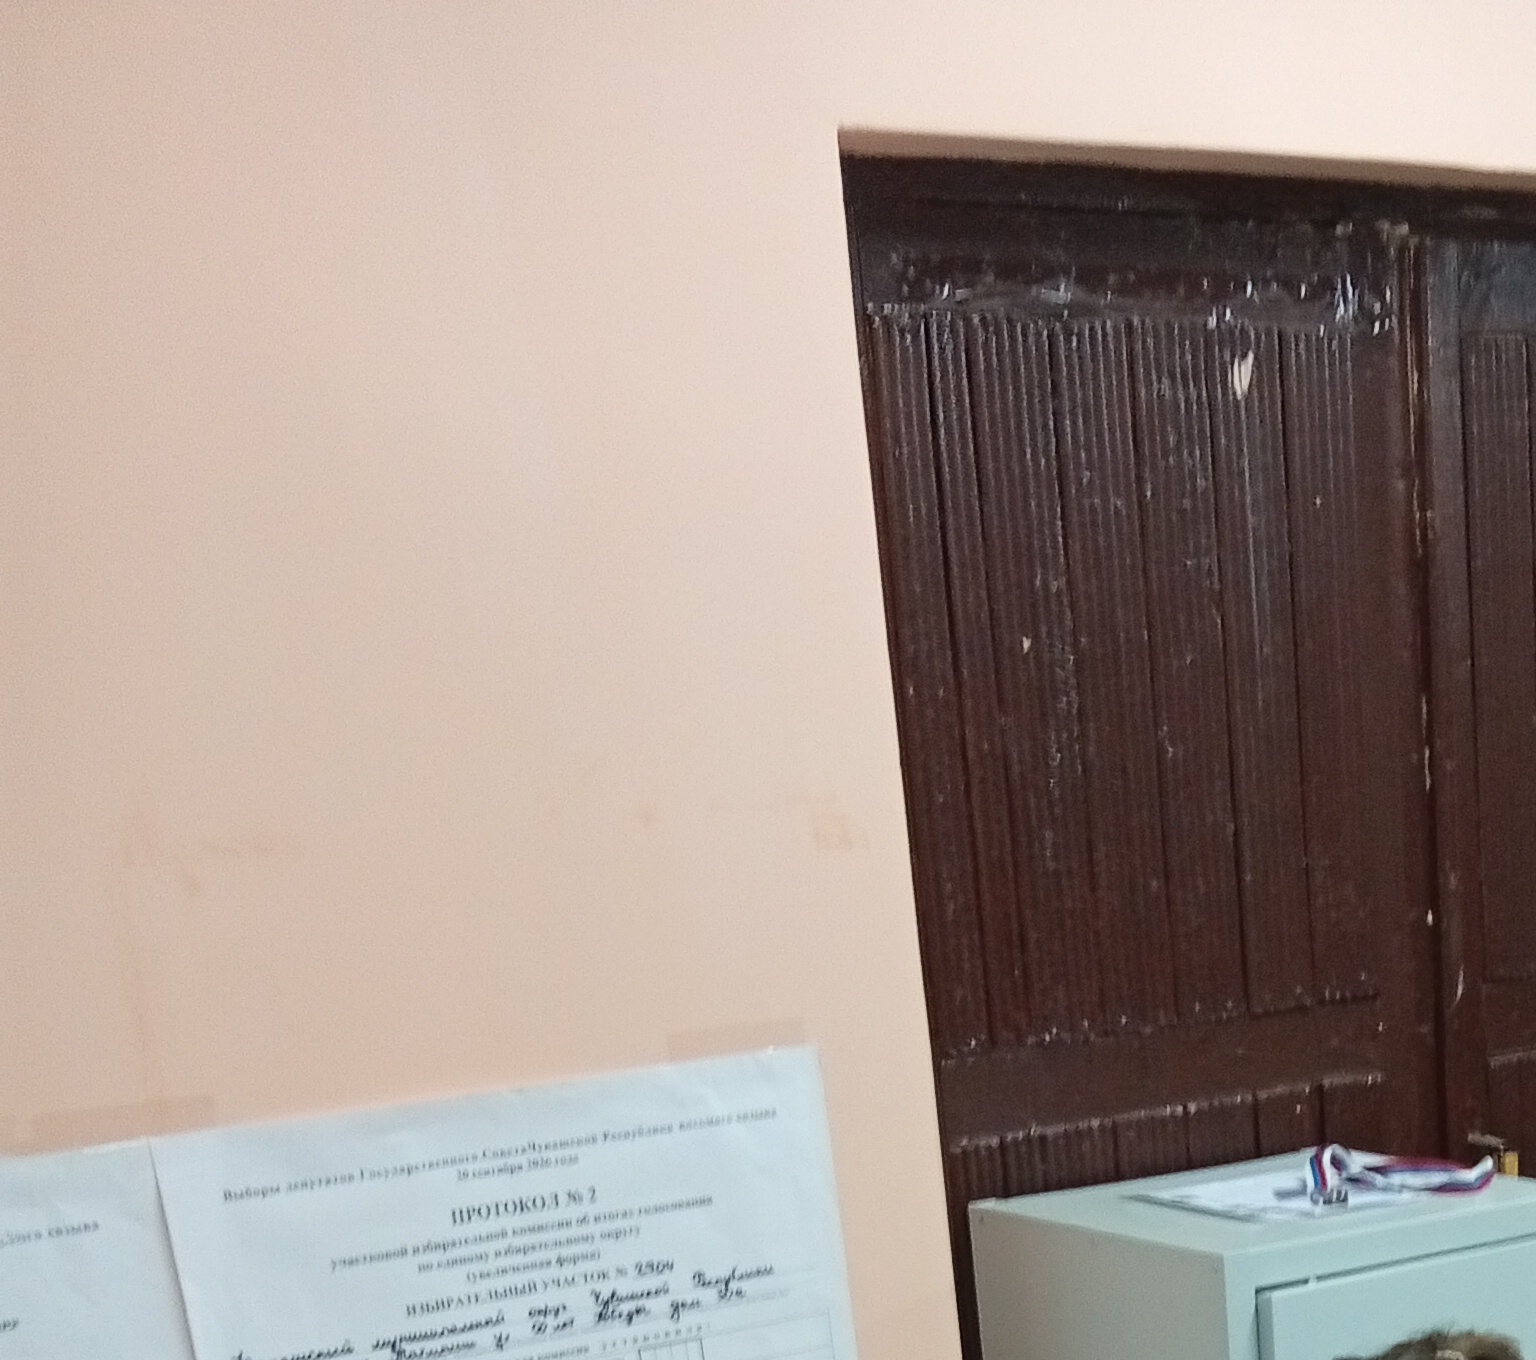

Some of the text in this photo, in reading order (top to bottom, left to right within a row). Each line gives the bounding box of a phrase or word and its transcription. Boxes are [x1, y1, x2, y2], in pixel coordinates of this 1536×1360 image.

[223, 1185, 280, 1202] Выборы
[286, 1173, 355, 1192] депутатов
[451, 1193, 559, 1225] ПРОТОКОЛ
[588, 1186, 596, 1203] 2
[406, 1281, 538, 1317] ИЗБИРАТЕЛЬНЫЙ
[542, 1270, 609, 1290] УЧАСТОК
